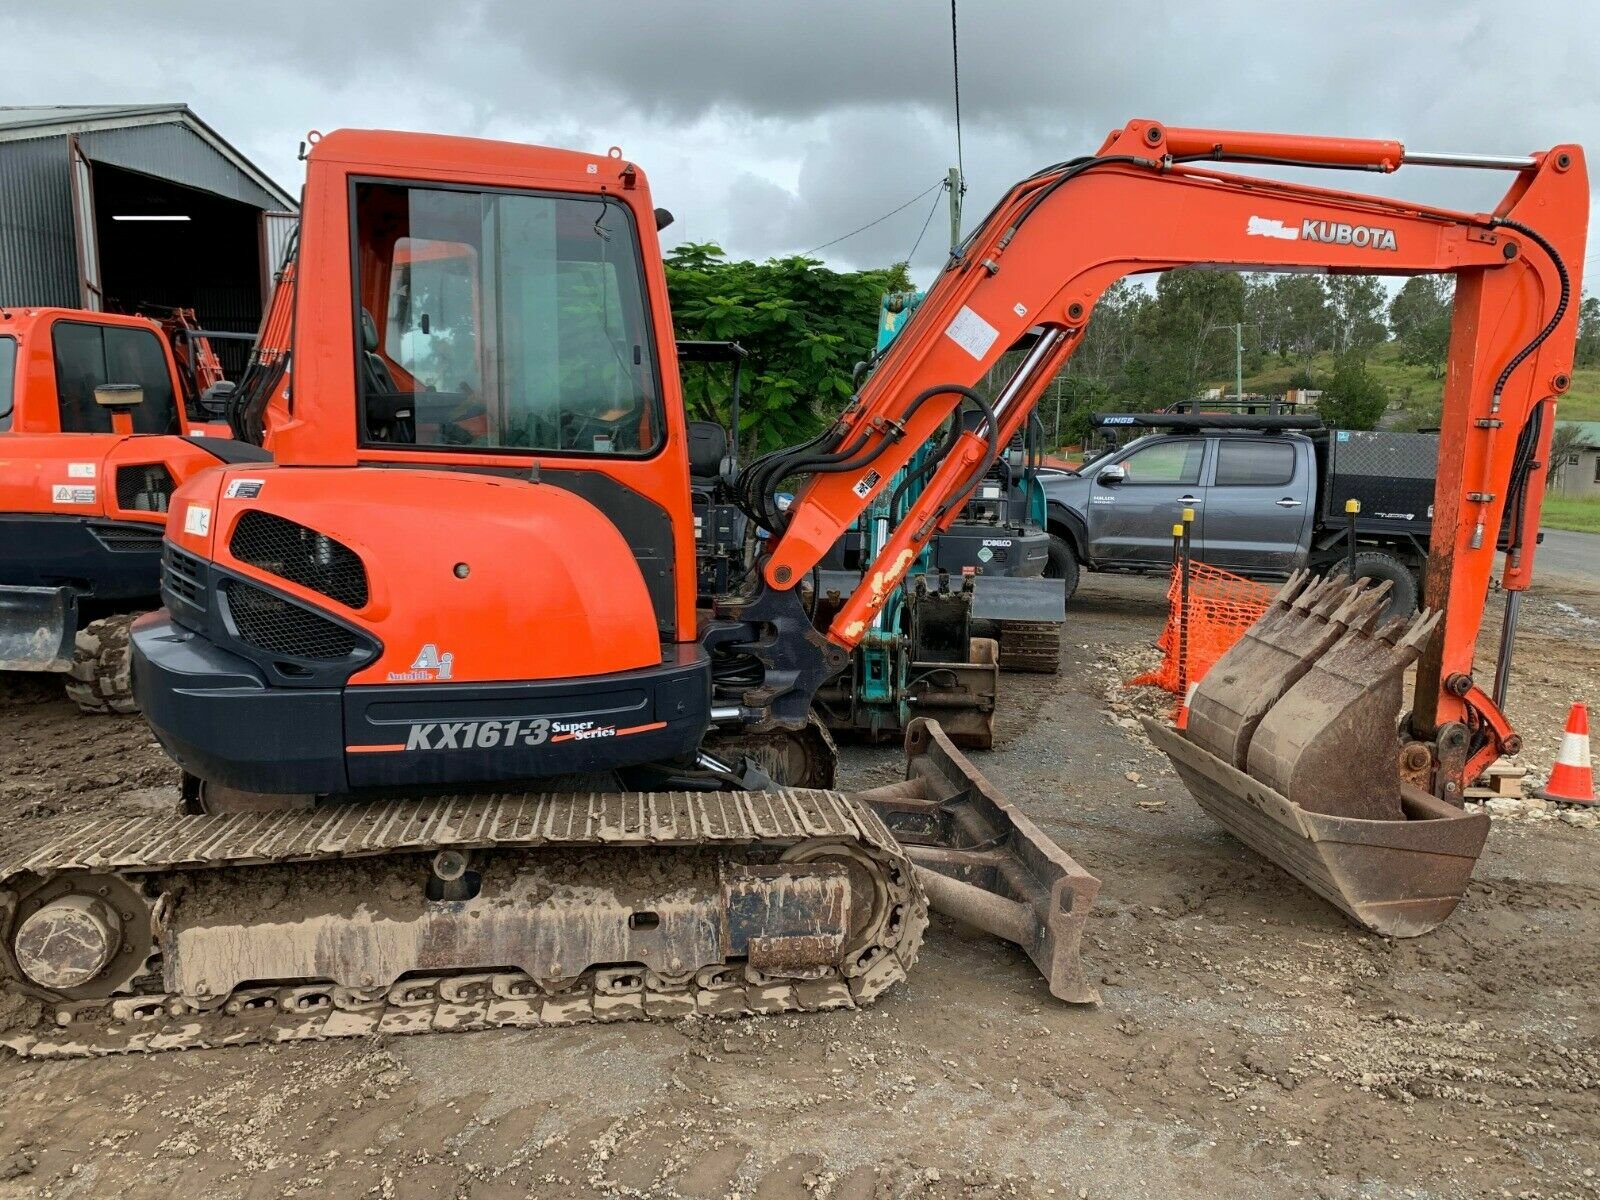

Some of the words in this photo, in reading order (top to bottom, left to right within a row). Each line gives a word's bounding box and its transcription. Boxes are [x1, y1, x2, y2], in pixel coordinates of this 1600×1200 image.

[1301, 219, 1398, 251] KUBOTA
[1103, 416, 1135, 424] KINGS
[982, 539, 1012, 547] KOBELCO
[405, 718, 551, 751] KX161-3
[551, 721, 594, 735] Super
[575, 726, 616, 741] Series
